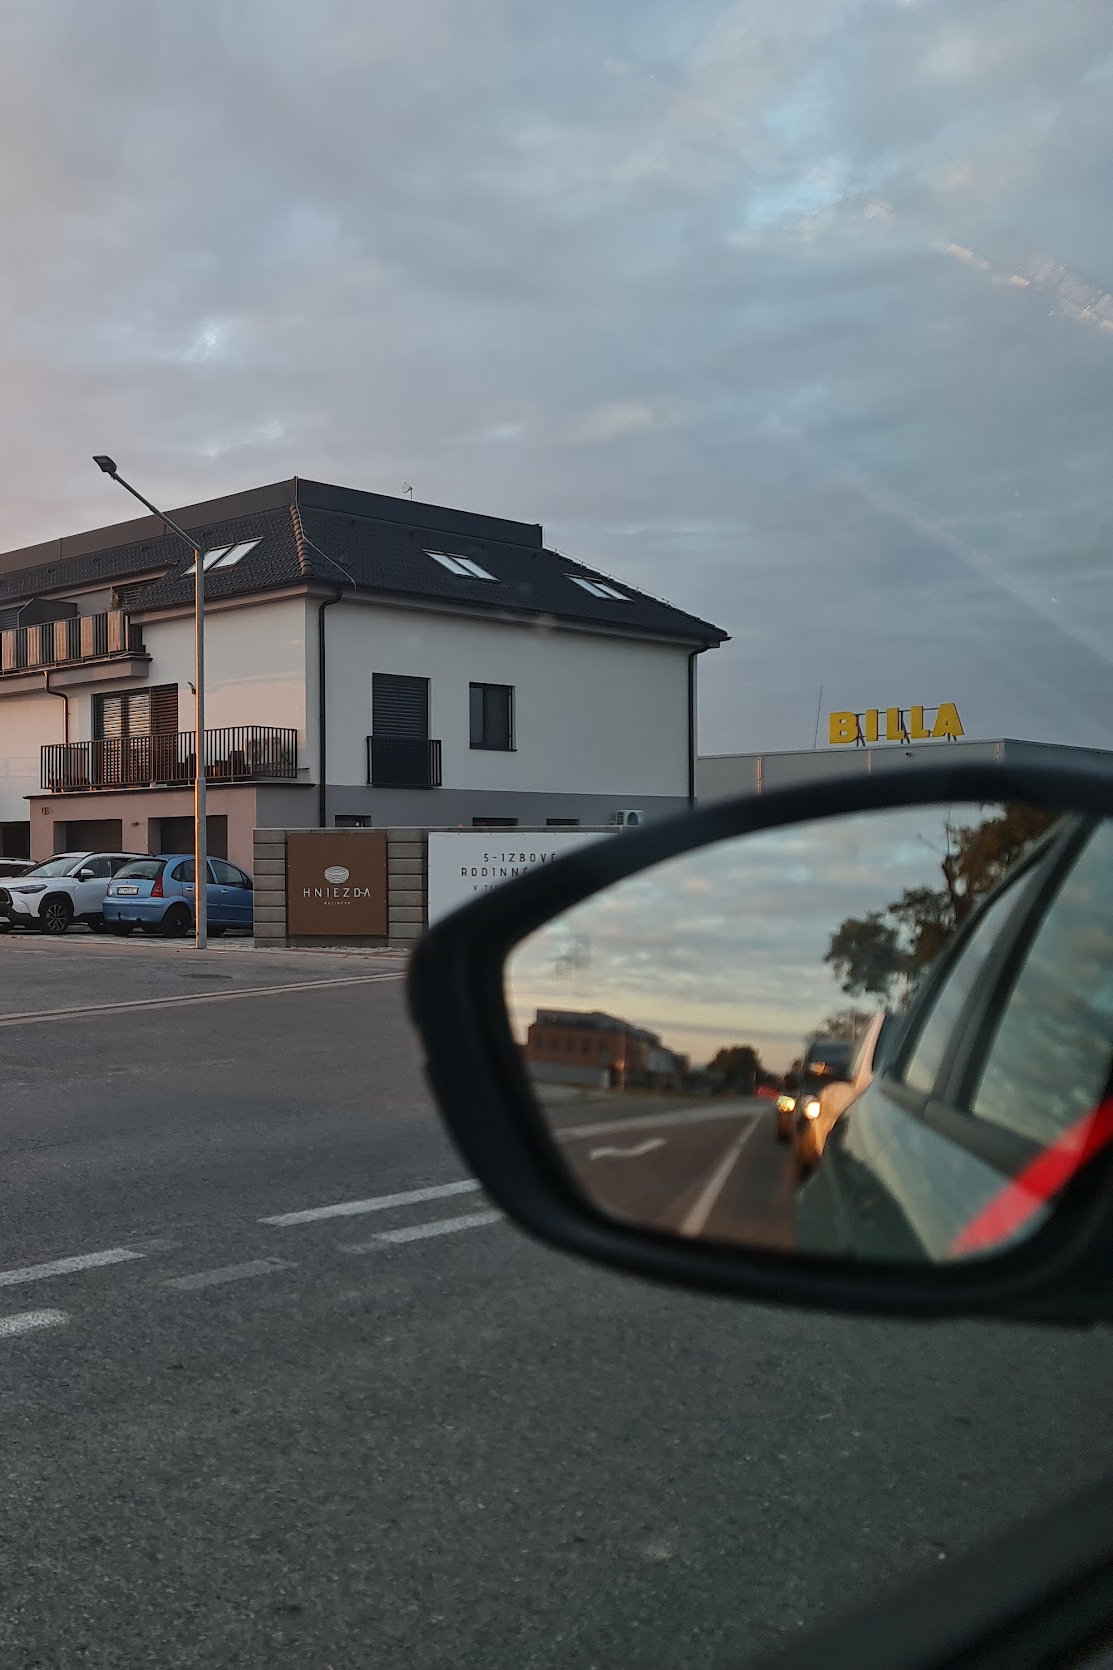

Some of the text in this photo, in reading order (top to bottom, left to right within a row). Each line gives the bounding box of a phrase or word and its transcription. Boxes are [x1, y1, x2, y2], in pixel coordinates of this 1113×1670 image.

[829, 702, 965, 744] BILLA
[483, 851, 556, 863] 5-IZBOVÉ
[303, 887, 371, 898] HNIEZDA
